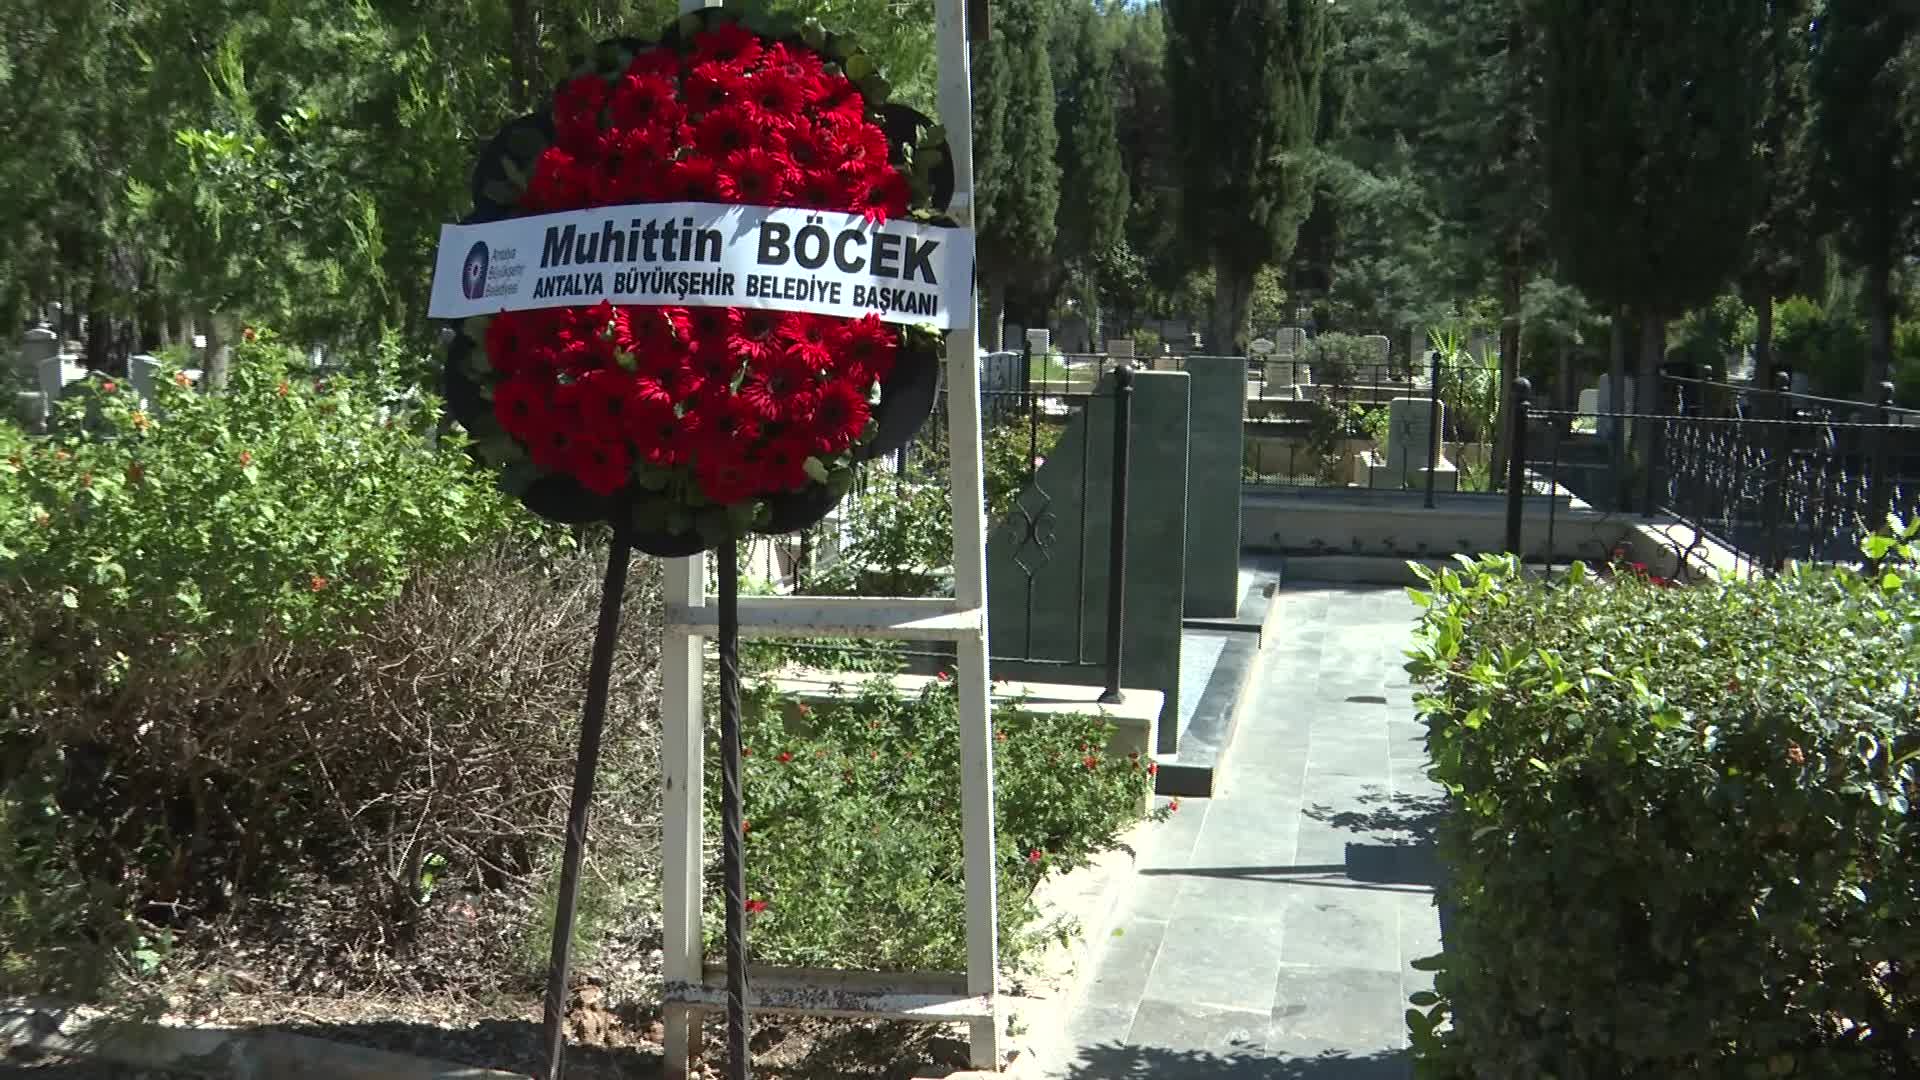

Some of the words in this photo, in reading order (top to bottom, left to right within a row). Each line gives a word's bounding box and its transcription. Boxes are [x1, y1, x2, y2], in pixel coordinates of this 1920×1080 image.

[540, 217, 722, 268] Muhittin
[757, 216, 940, 285] BÖCEK
[533, 272, 603, 299] ANTALYA
[614, 266, 735, 300] BÜYÜKŞEHİR
[746, 274, 842, 304] BELEDİYE
[853, 284, 938, 316] BAŞKANI
